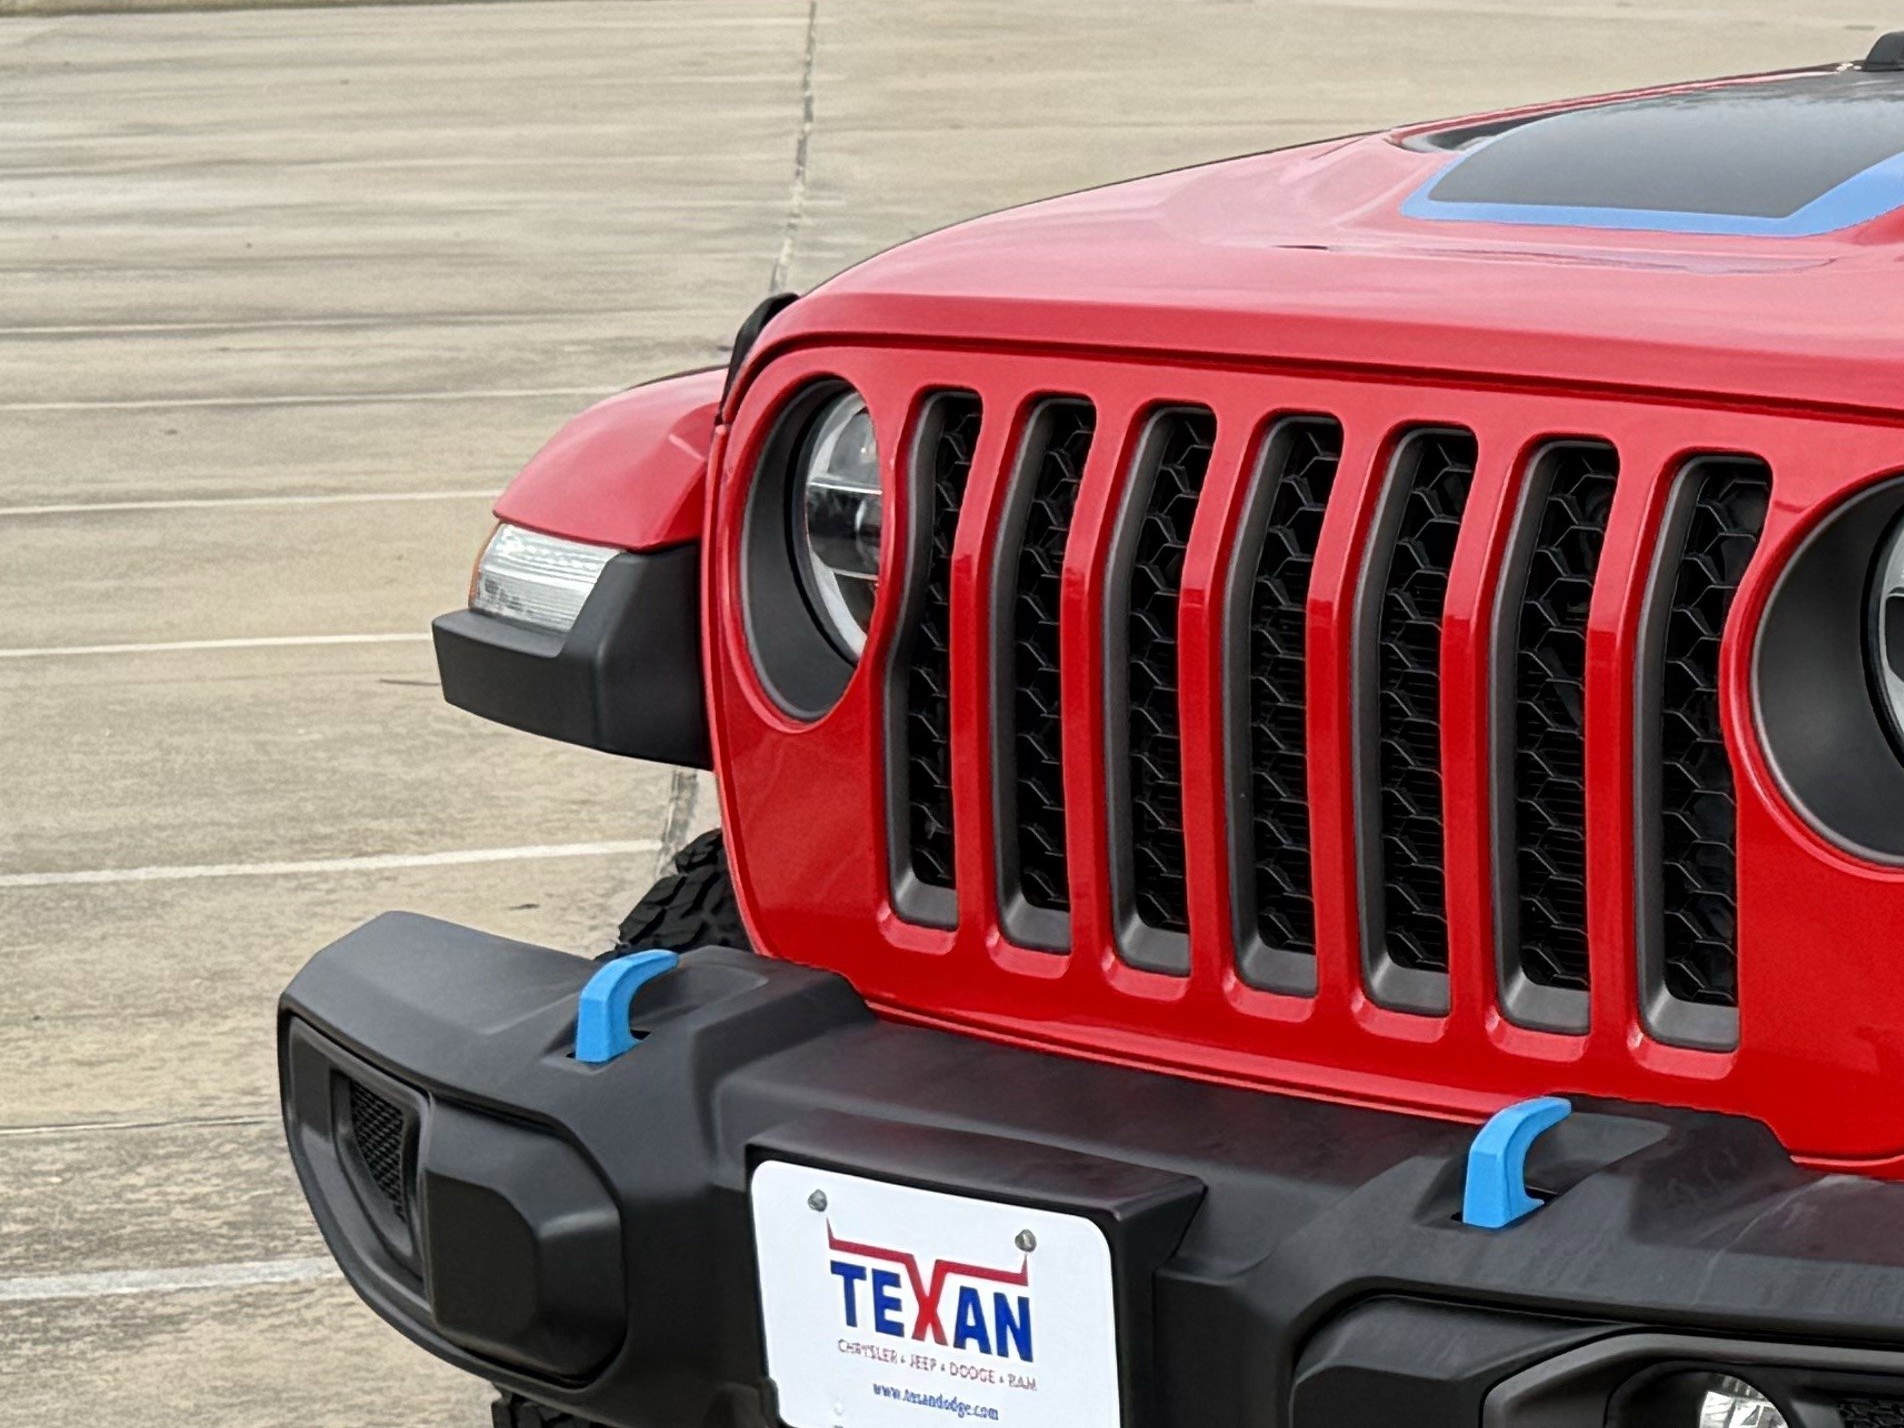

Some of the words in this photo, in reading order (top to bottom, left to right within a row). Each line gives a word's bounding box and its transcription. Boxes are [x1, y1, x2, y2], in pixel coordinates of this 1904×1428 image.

[827, 1218, 1034, 1363] TEXAN
[837, 1338, 898, 1365] CHRYSLER
[909, 1353, 938, 1372] JEEP
[949, 1360, 996, 1385] DODGE
[1008, 1372, 1038, 1392] RAM
